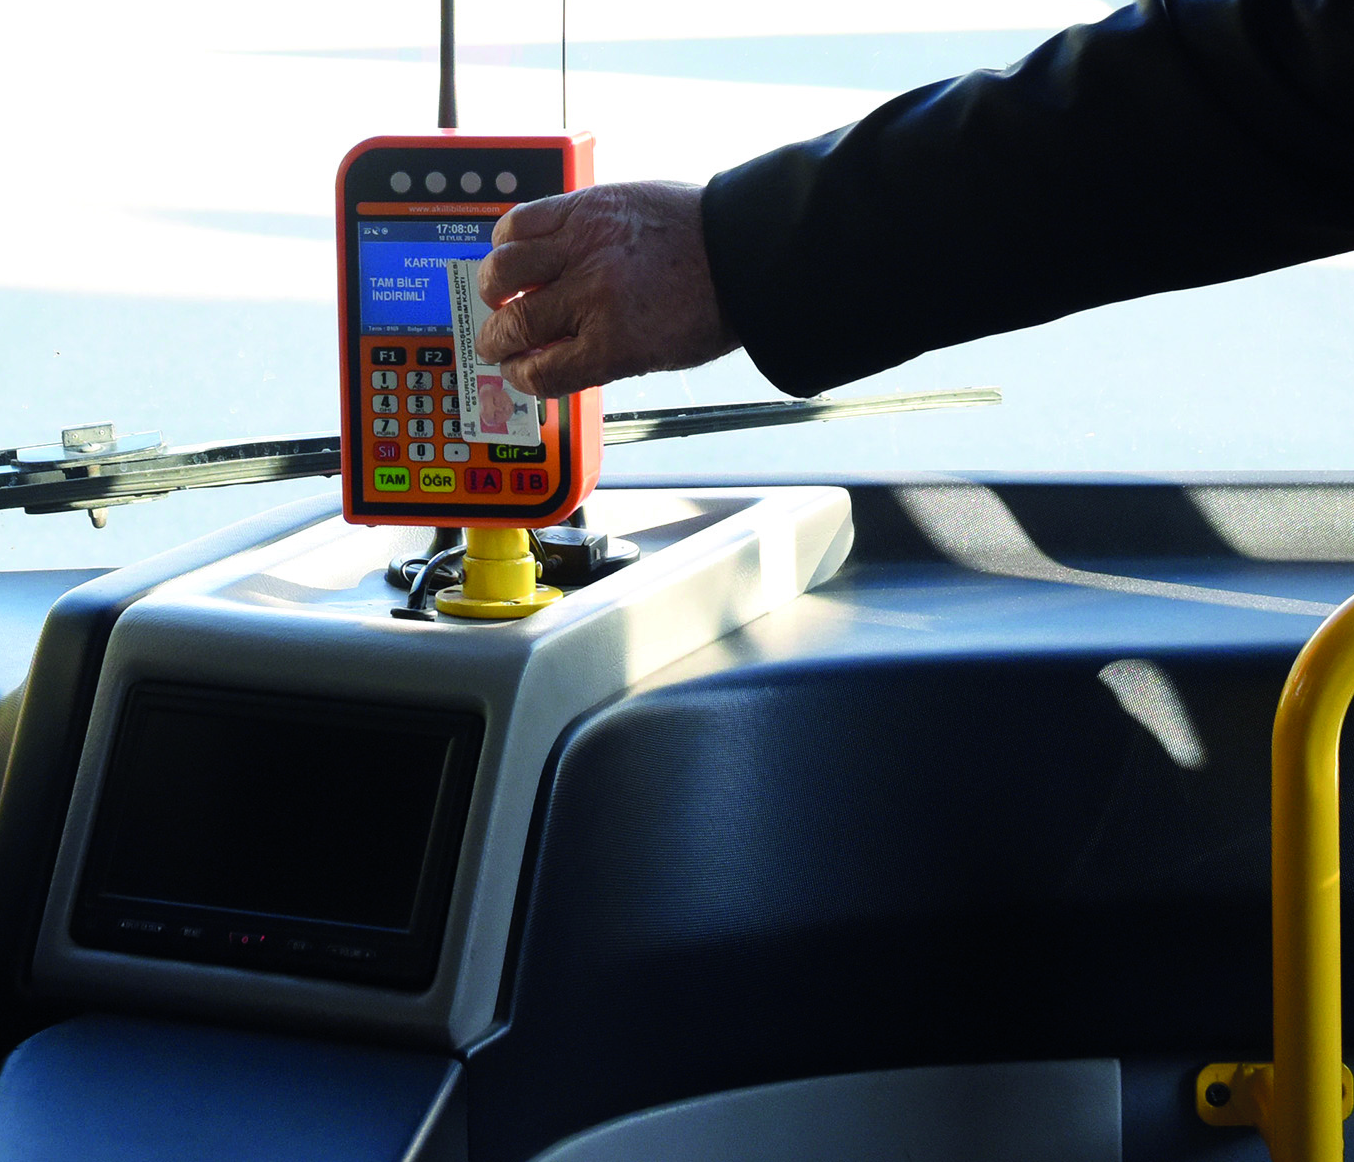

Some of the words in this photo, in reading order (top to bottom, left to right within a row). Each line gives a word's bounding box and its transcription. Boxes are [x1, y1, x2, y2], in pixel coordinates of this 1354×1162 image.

[436, 224, 480, 234] 17:08:04
[370, 278, 394, 288] TAM
[396, 276, 430, 288] BİLET
[372, 290, 425, 301] İNDİRİMLİ
[379, 351, 397, 362] F1
[425, 351, 443, 362] F2
[468, 363, 474, 375] VE
[381, 372, 387, 384] 1
[415, 372, 424, 385] 2
[450, 373, 458, 385] 3
[463, 371, 472, 412] ERZURUM
[381, 396, 391, 408] 4
[415, 396, 424, 408] 5
[451, 397, 459, 409] 6
[382, 420, 390, 432] 7
[416, 420, 425, 433] 8
[451, 420, 460, 433] 9
[379, 446, 395, 458] Sil
[417, 444, 425, 456] 0
[496, 444, 520, 459] Gir
[378, 474, 406, 485] TAM
[422, 473, 452, 487] ÖĞR
[483, 473, 497, 489] A
[529, 474, 543, 490] B
